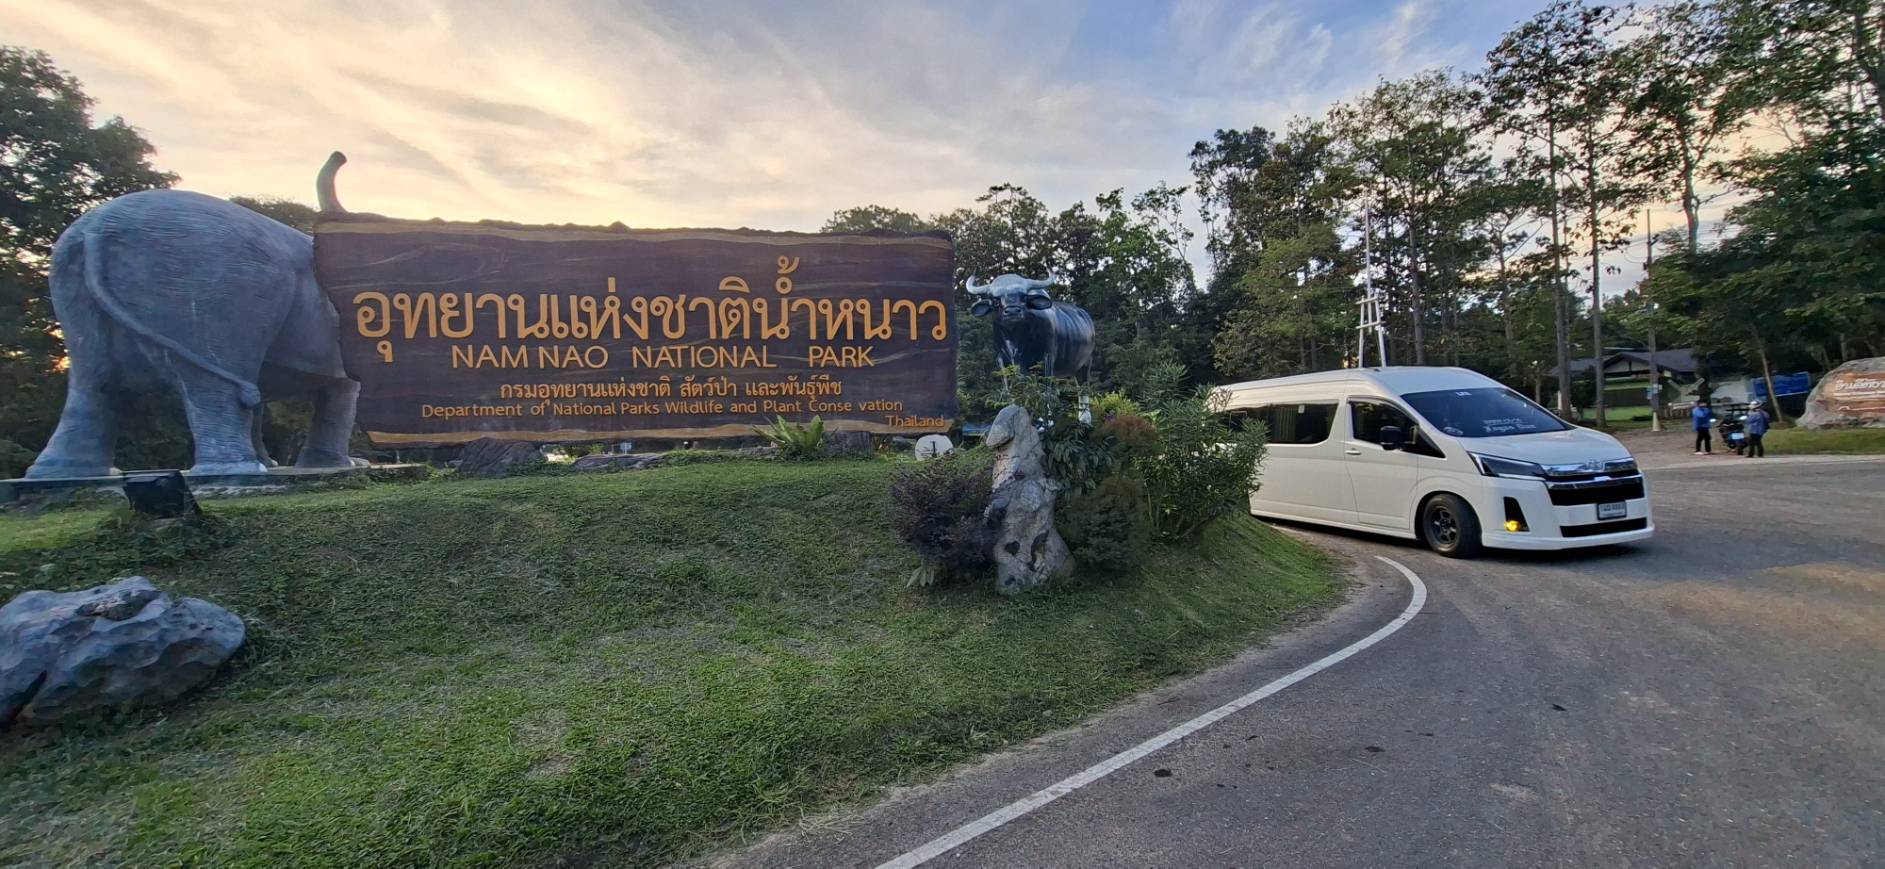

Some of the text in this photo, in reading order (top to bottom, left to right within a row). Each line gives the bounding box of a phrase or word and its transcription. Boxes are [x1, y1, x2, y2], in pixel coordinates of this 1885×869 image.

[352, 255, 948, 363] อุทยานแห่งชาติน้ำหนาว
[451, 344, 876, 369] NAM NAO NATIONAL PARK
[679, 374, 737, 397] สัตว์ป่า
[745, 374, 842, 400] และพันธุ์พืช
[421, 403, 523, 420] Department
[530, 401, 547, 416] of
[553, 401, 616, 416] National
[621, 401, 660, 415] Parks
[665, 400, 724, 415] Wildlife
[730, 401, 757, 414] and
[763, 399, 801, 414] Plant
[885, 415, 944, 428] Thailand
